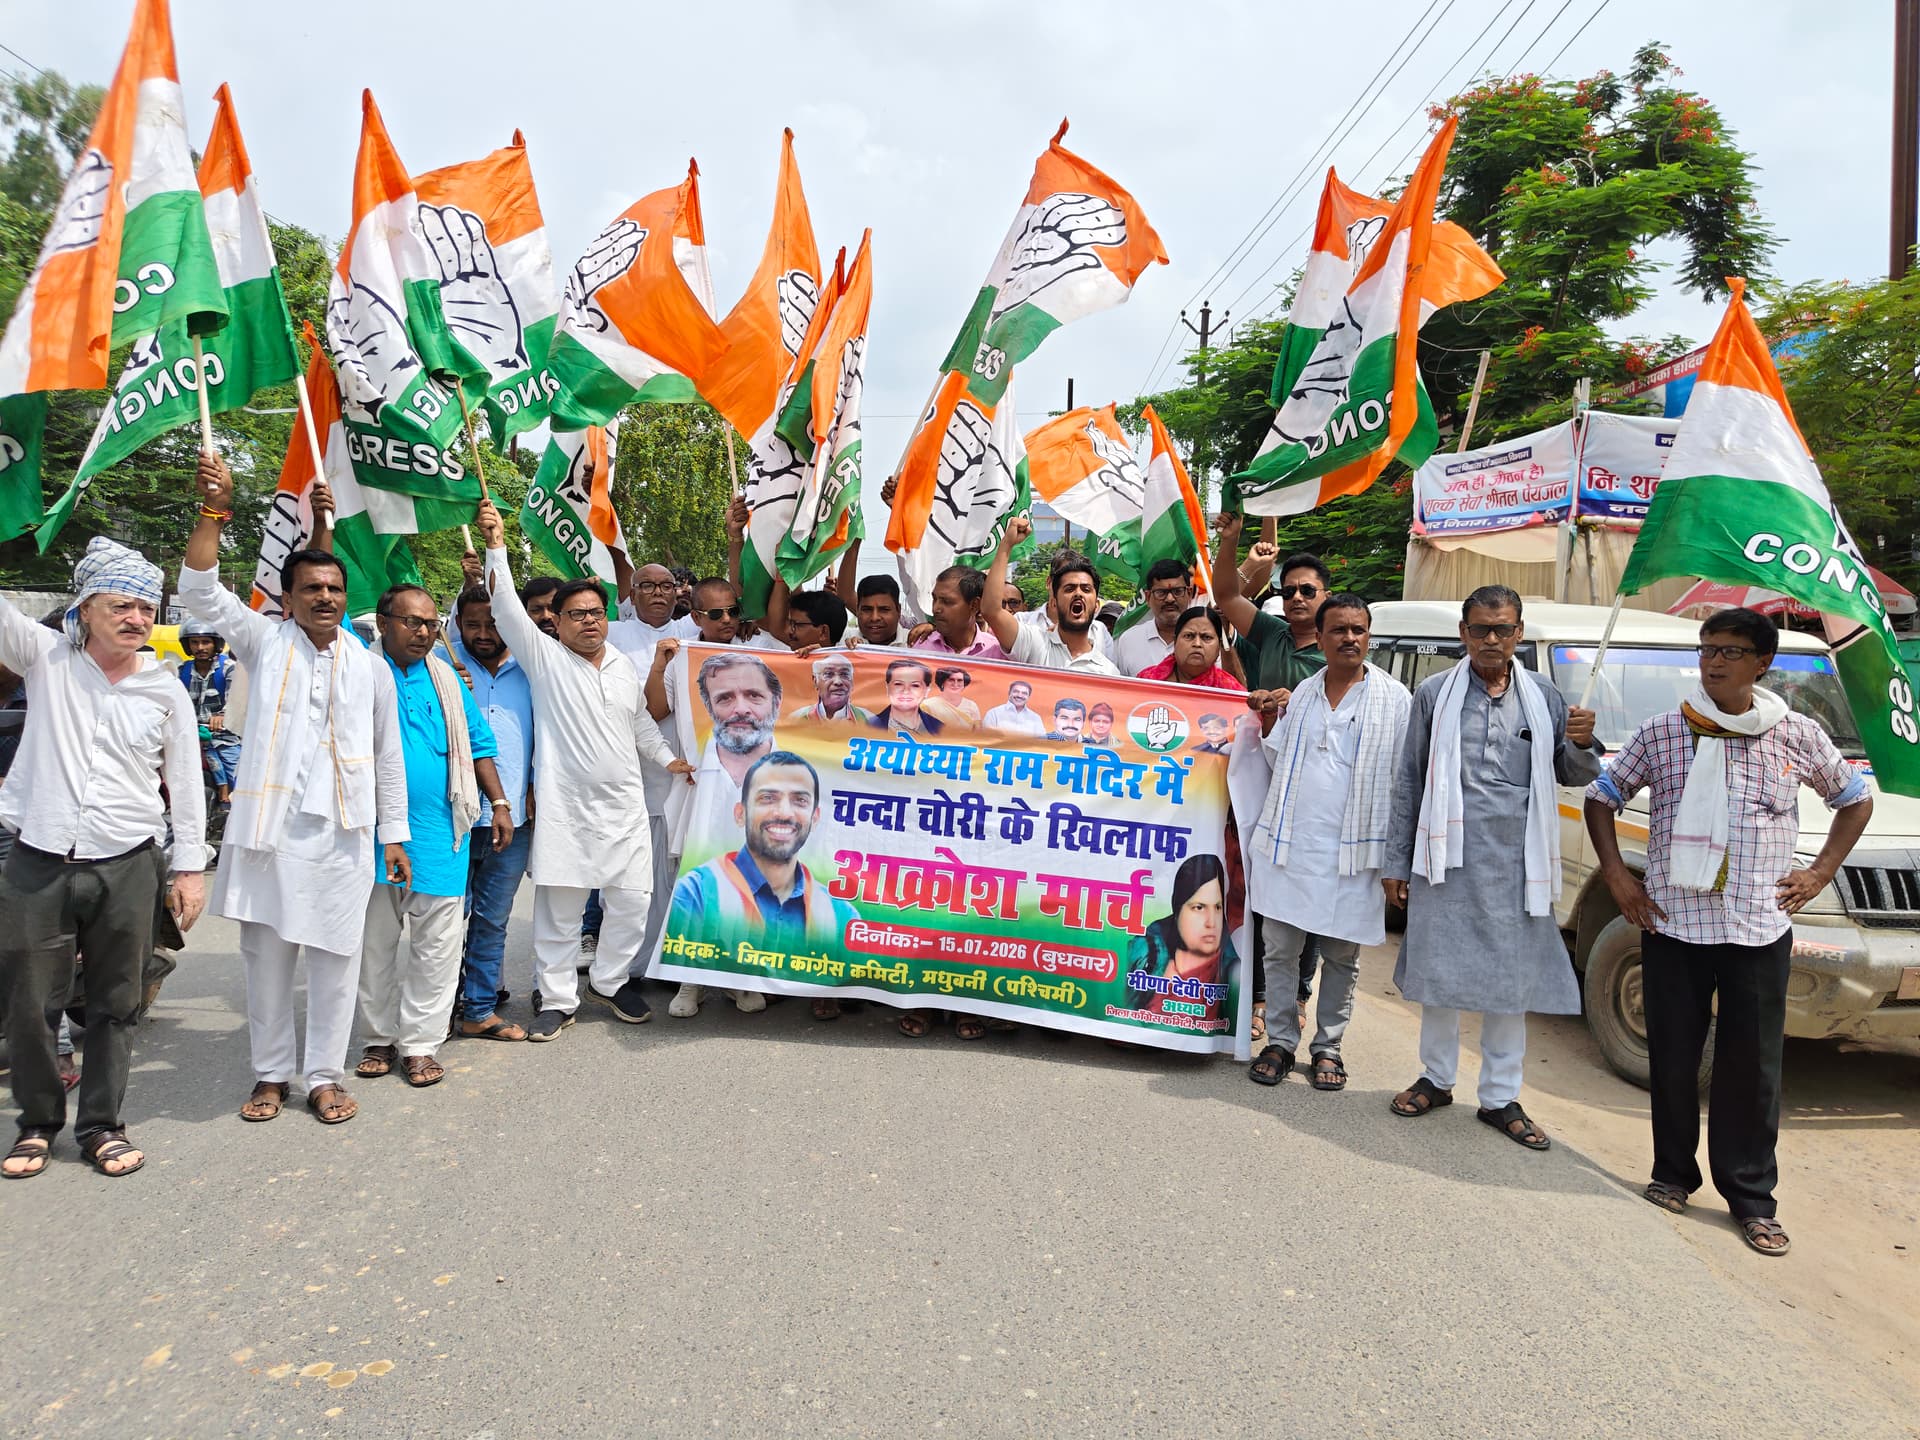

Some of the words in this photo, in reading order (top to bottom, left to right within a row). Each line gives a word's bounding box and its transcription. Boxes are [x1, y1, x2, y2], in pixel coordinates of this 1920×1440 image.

[345, 427, 466, 483] GRESS
[1424, 498, 1457, 516] शुल्क
[1458, 494, 1484, 512] सेवा
[1485, 488, 1518, 512] शीतल
[1521, 480, 1569, 504] पेयजल
[1443, 480, 1469, 494] जल
[1471, 473, 1486, 490] ही
[1488, 468, 1525, 488] जीवन
[843, 731, 978, 782] अयोध्या
[982, 747, 1049, 790] राम
[1053, 746, 1149, 801] मंदिर
[1153, 755, 1195, 806] में
[831, 789, 911, 832] चन्दा
[917, 788, 992, 841] चोरी
[998, 797, 1040, 845] के
[1046, 801, 1193, 864] खिलाफ
[827, 845, 1028, 921] आक्रोश
[1035, 868, 1156, 938] मार्च
[735, 941, 787, 969] जिला
[790, 950, 846, 978] कांग्रेस
[849, 959, 916, 989] कमिटी,
[993, 974, 1089, 1009] (पश्चिमी)
[939, 936, 1028, 961] 15.07.2026
[1032, 943, 1115, 979] (बुधवार)
[1127, 970, 1170, 994] मीणा
[1172, 975, 1202, 999] देवी
[1104, 1003, 1130, 1019] जिला
[1161, 998, 1206, 1018] अध्यक्ष
